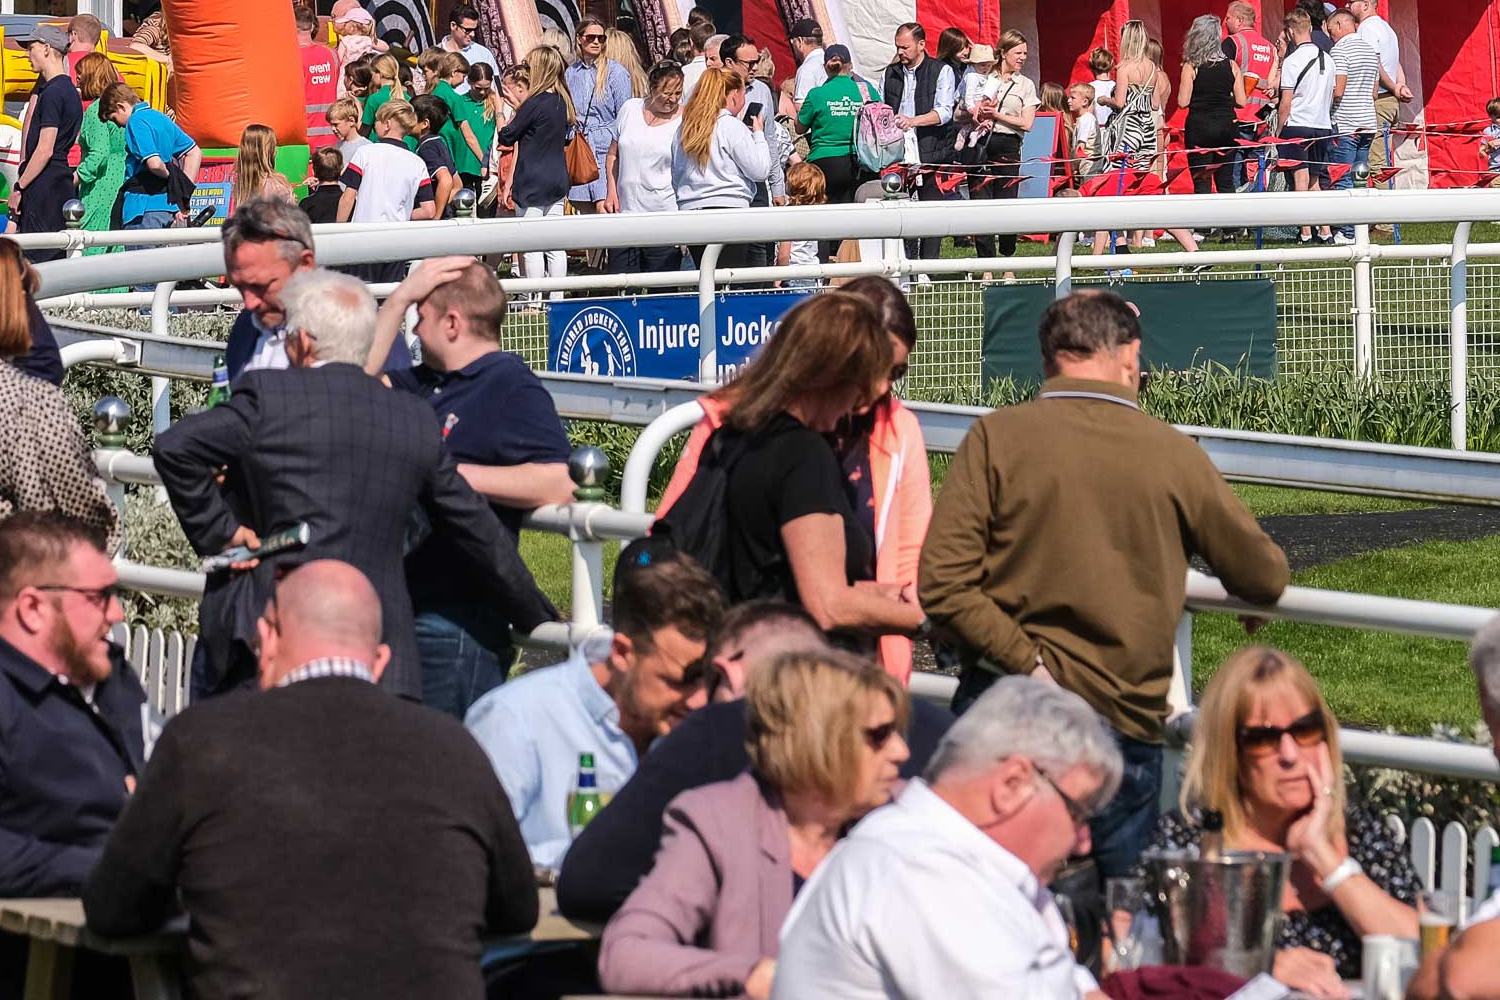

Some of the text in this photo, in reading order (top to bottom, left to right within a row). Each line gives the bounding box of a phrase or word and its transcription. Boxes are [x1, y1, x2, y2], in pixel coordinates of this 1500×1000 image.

[309, 62, 330, 73] event
[311, 75, 331, 85] crew
[560, 313, 632, 366] INJURED JOCKEYS FUND
[638, 315, 782, 355] Injure Jock
